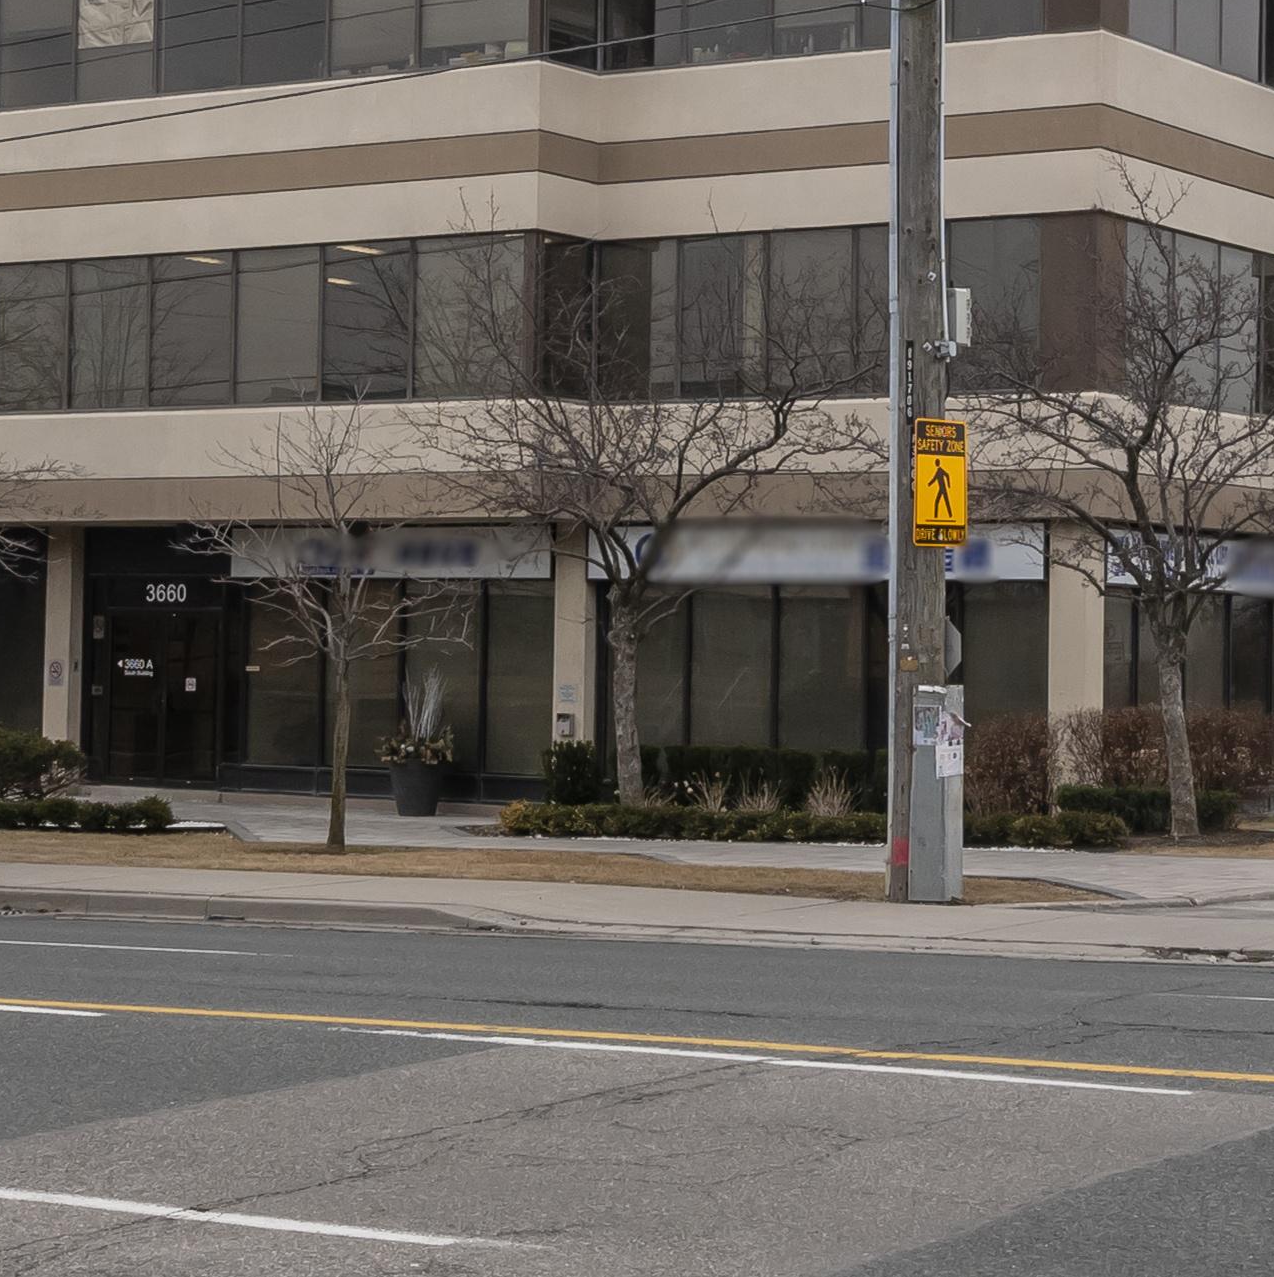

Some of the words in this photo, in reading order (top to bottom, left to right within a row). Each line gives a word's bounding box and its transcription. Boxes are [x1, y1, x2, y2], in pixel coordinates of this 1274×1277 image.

[925, 424, 957, 439] SENIORS
[916, 437, 944, 452] SAFETY
[946, 439, 965, 453] ZONE
[145, 583, 187, 602] 3660
[124, 658, 145, 669] 3660
[146, 659, 153, 669] A
